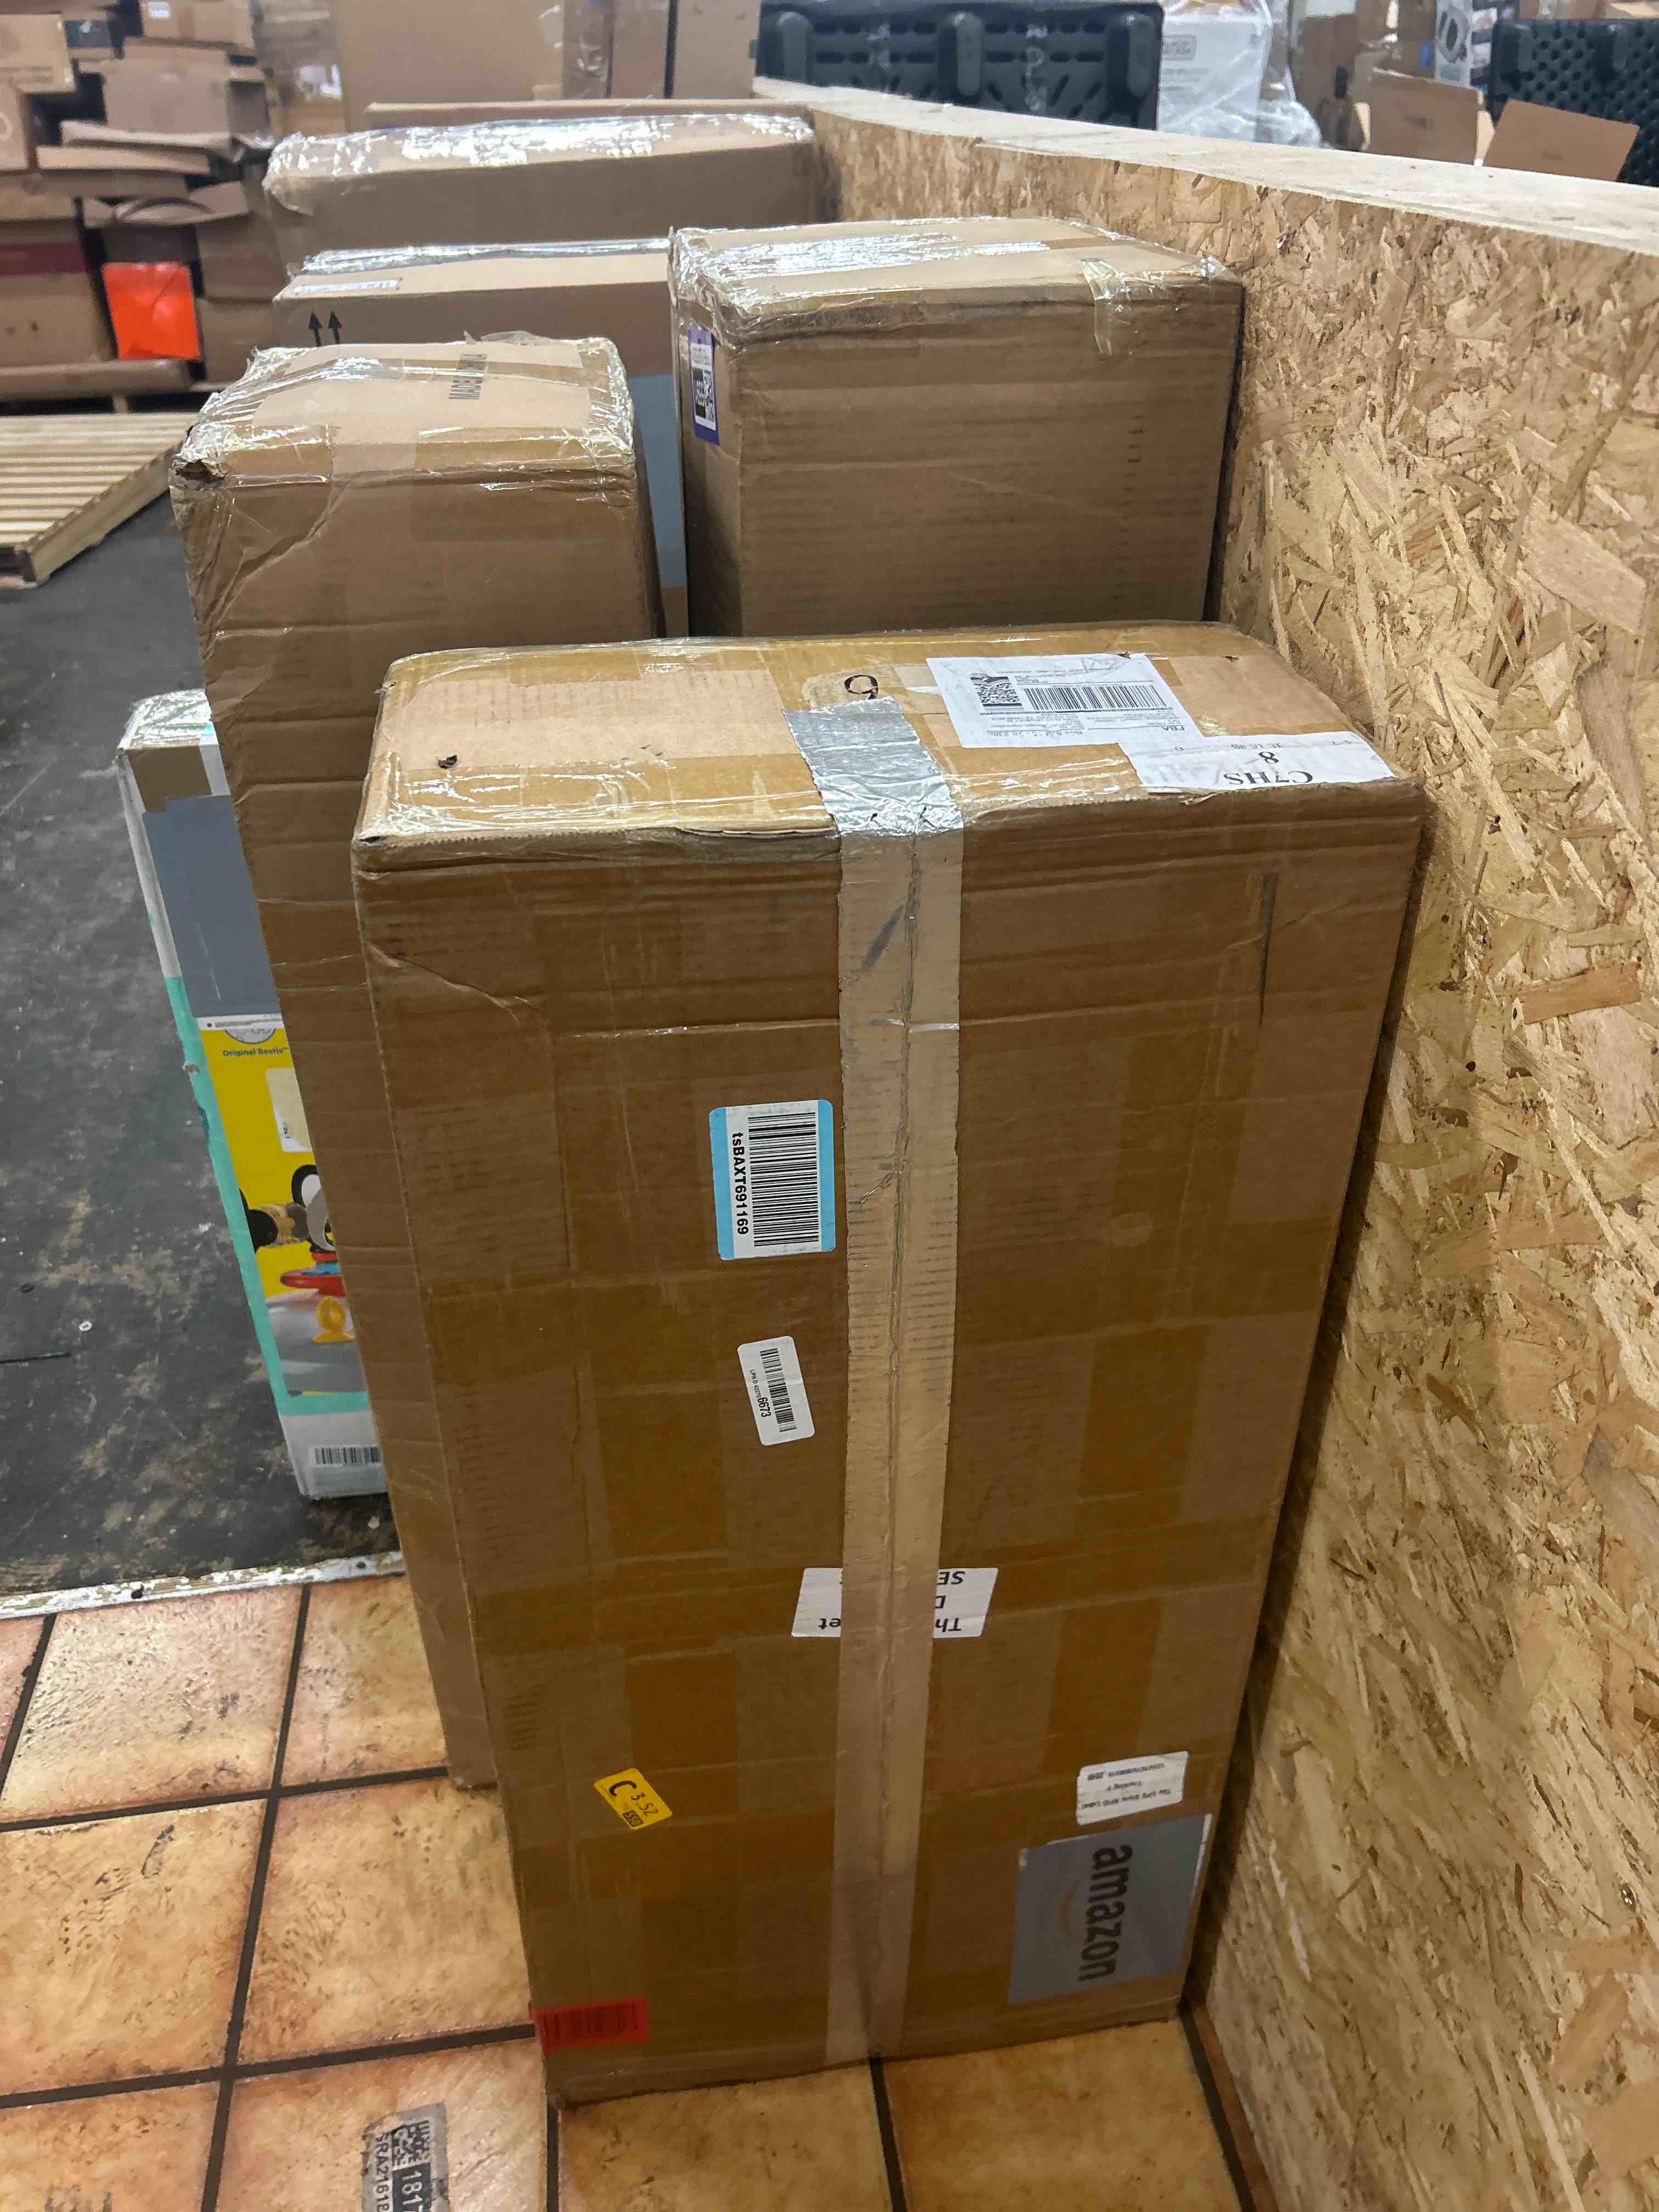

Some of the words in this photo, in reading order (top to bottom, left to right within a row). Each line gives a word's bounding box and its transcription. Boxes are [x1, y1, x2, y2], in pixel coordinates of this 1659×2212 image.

[1258, 751, 1279, 764] 8
[1223, 770, 1313, 786] C7HS
[222, 1047, 256, 1057] Original
[732, 1132, 749, 1235] tsBAXT691169
[1077, 1844, 1132, 1982] amazon
